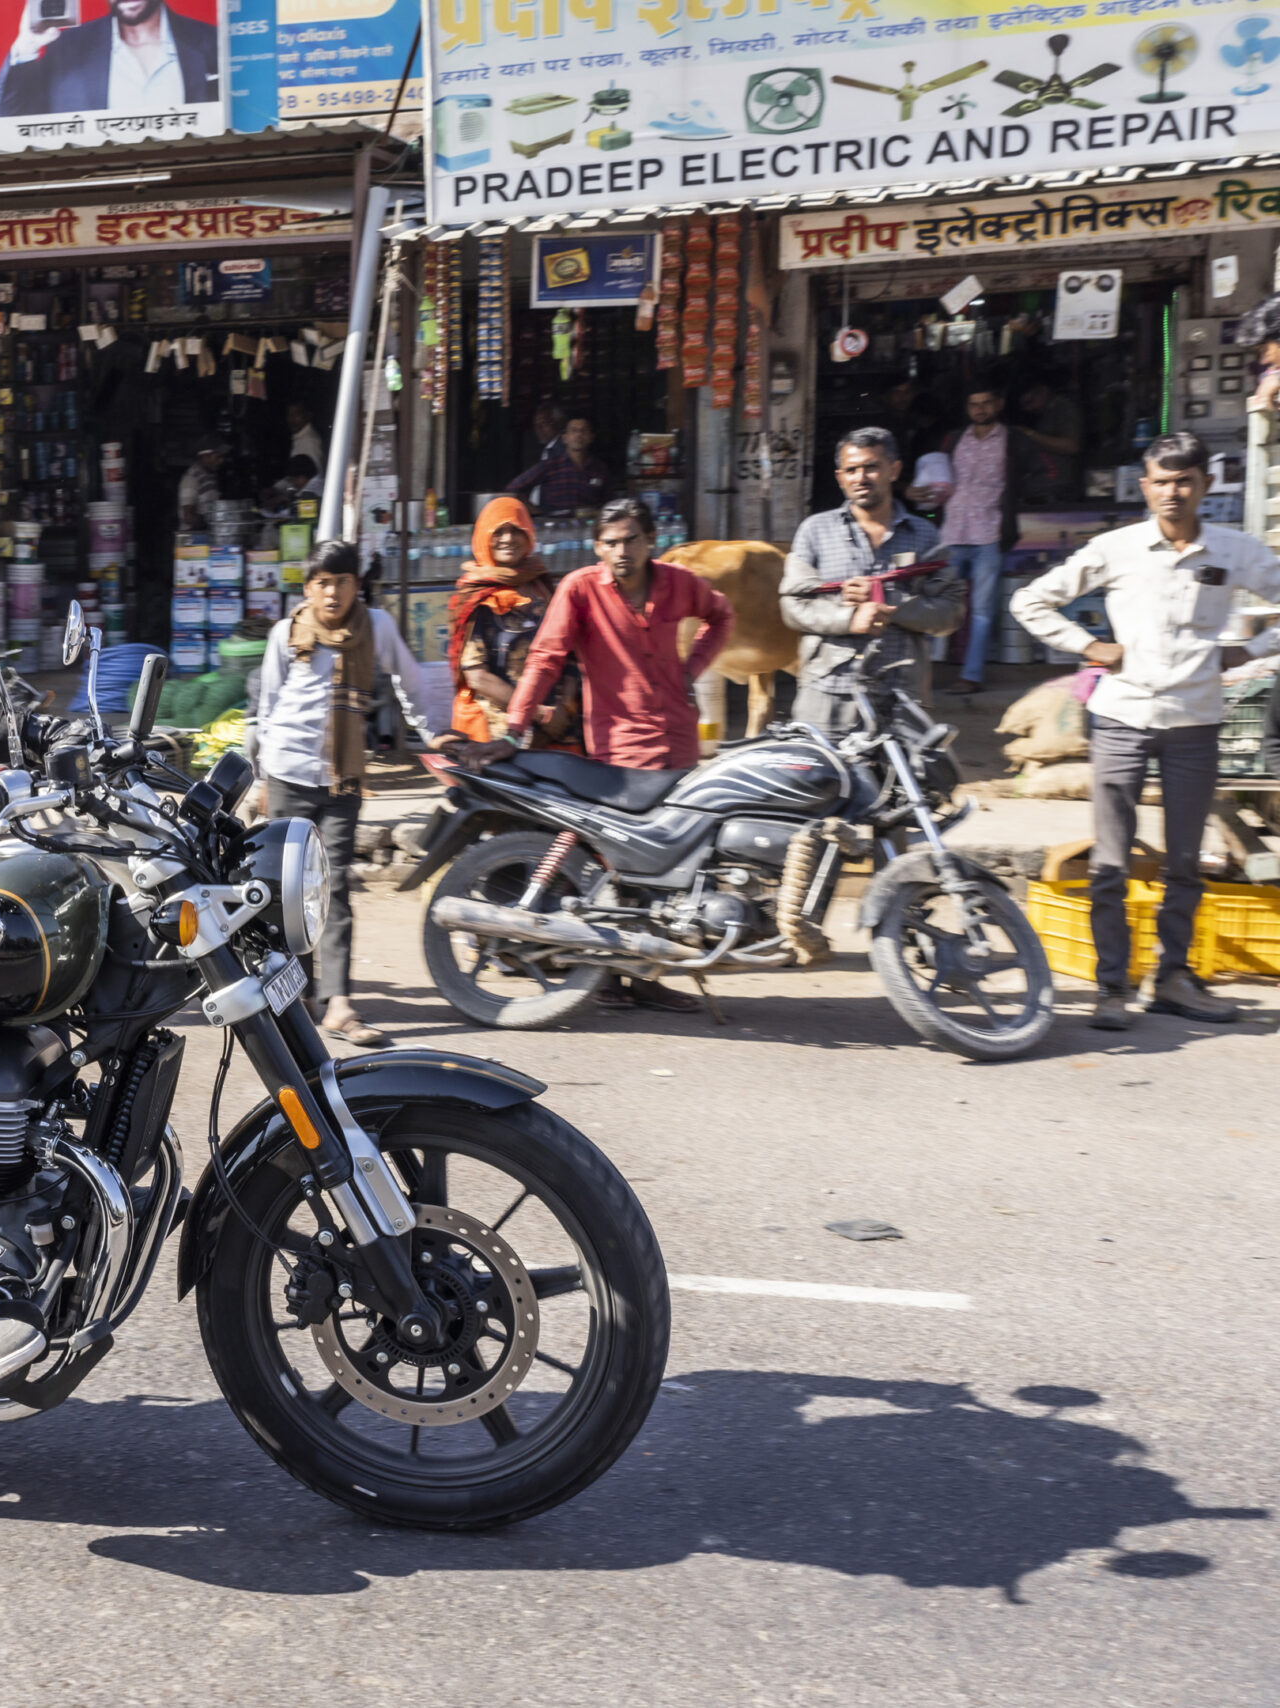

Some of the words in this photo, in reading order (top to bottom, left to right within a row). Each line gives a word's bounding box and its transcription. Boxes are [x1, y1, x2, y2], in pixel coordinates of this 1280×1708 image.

[439, 64, 491, 86] हमारे
[544, 58, 570, 72] पर
[934, 15, 979, 33] तथा
[17, 115, 85, 137] बालाजी
[454, 158, 664, 206] PRADEEP
[681, 136, 911, 187] ELECTRIC
[927, 124, 1030, 165] AND
[1050, 105, 1237, 154] REPAIR
[795, 214, 909, 260] प्रदीप
